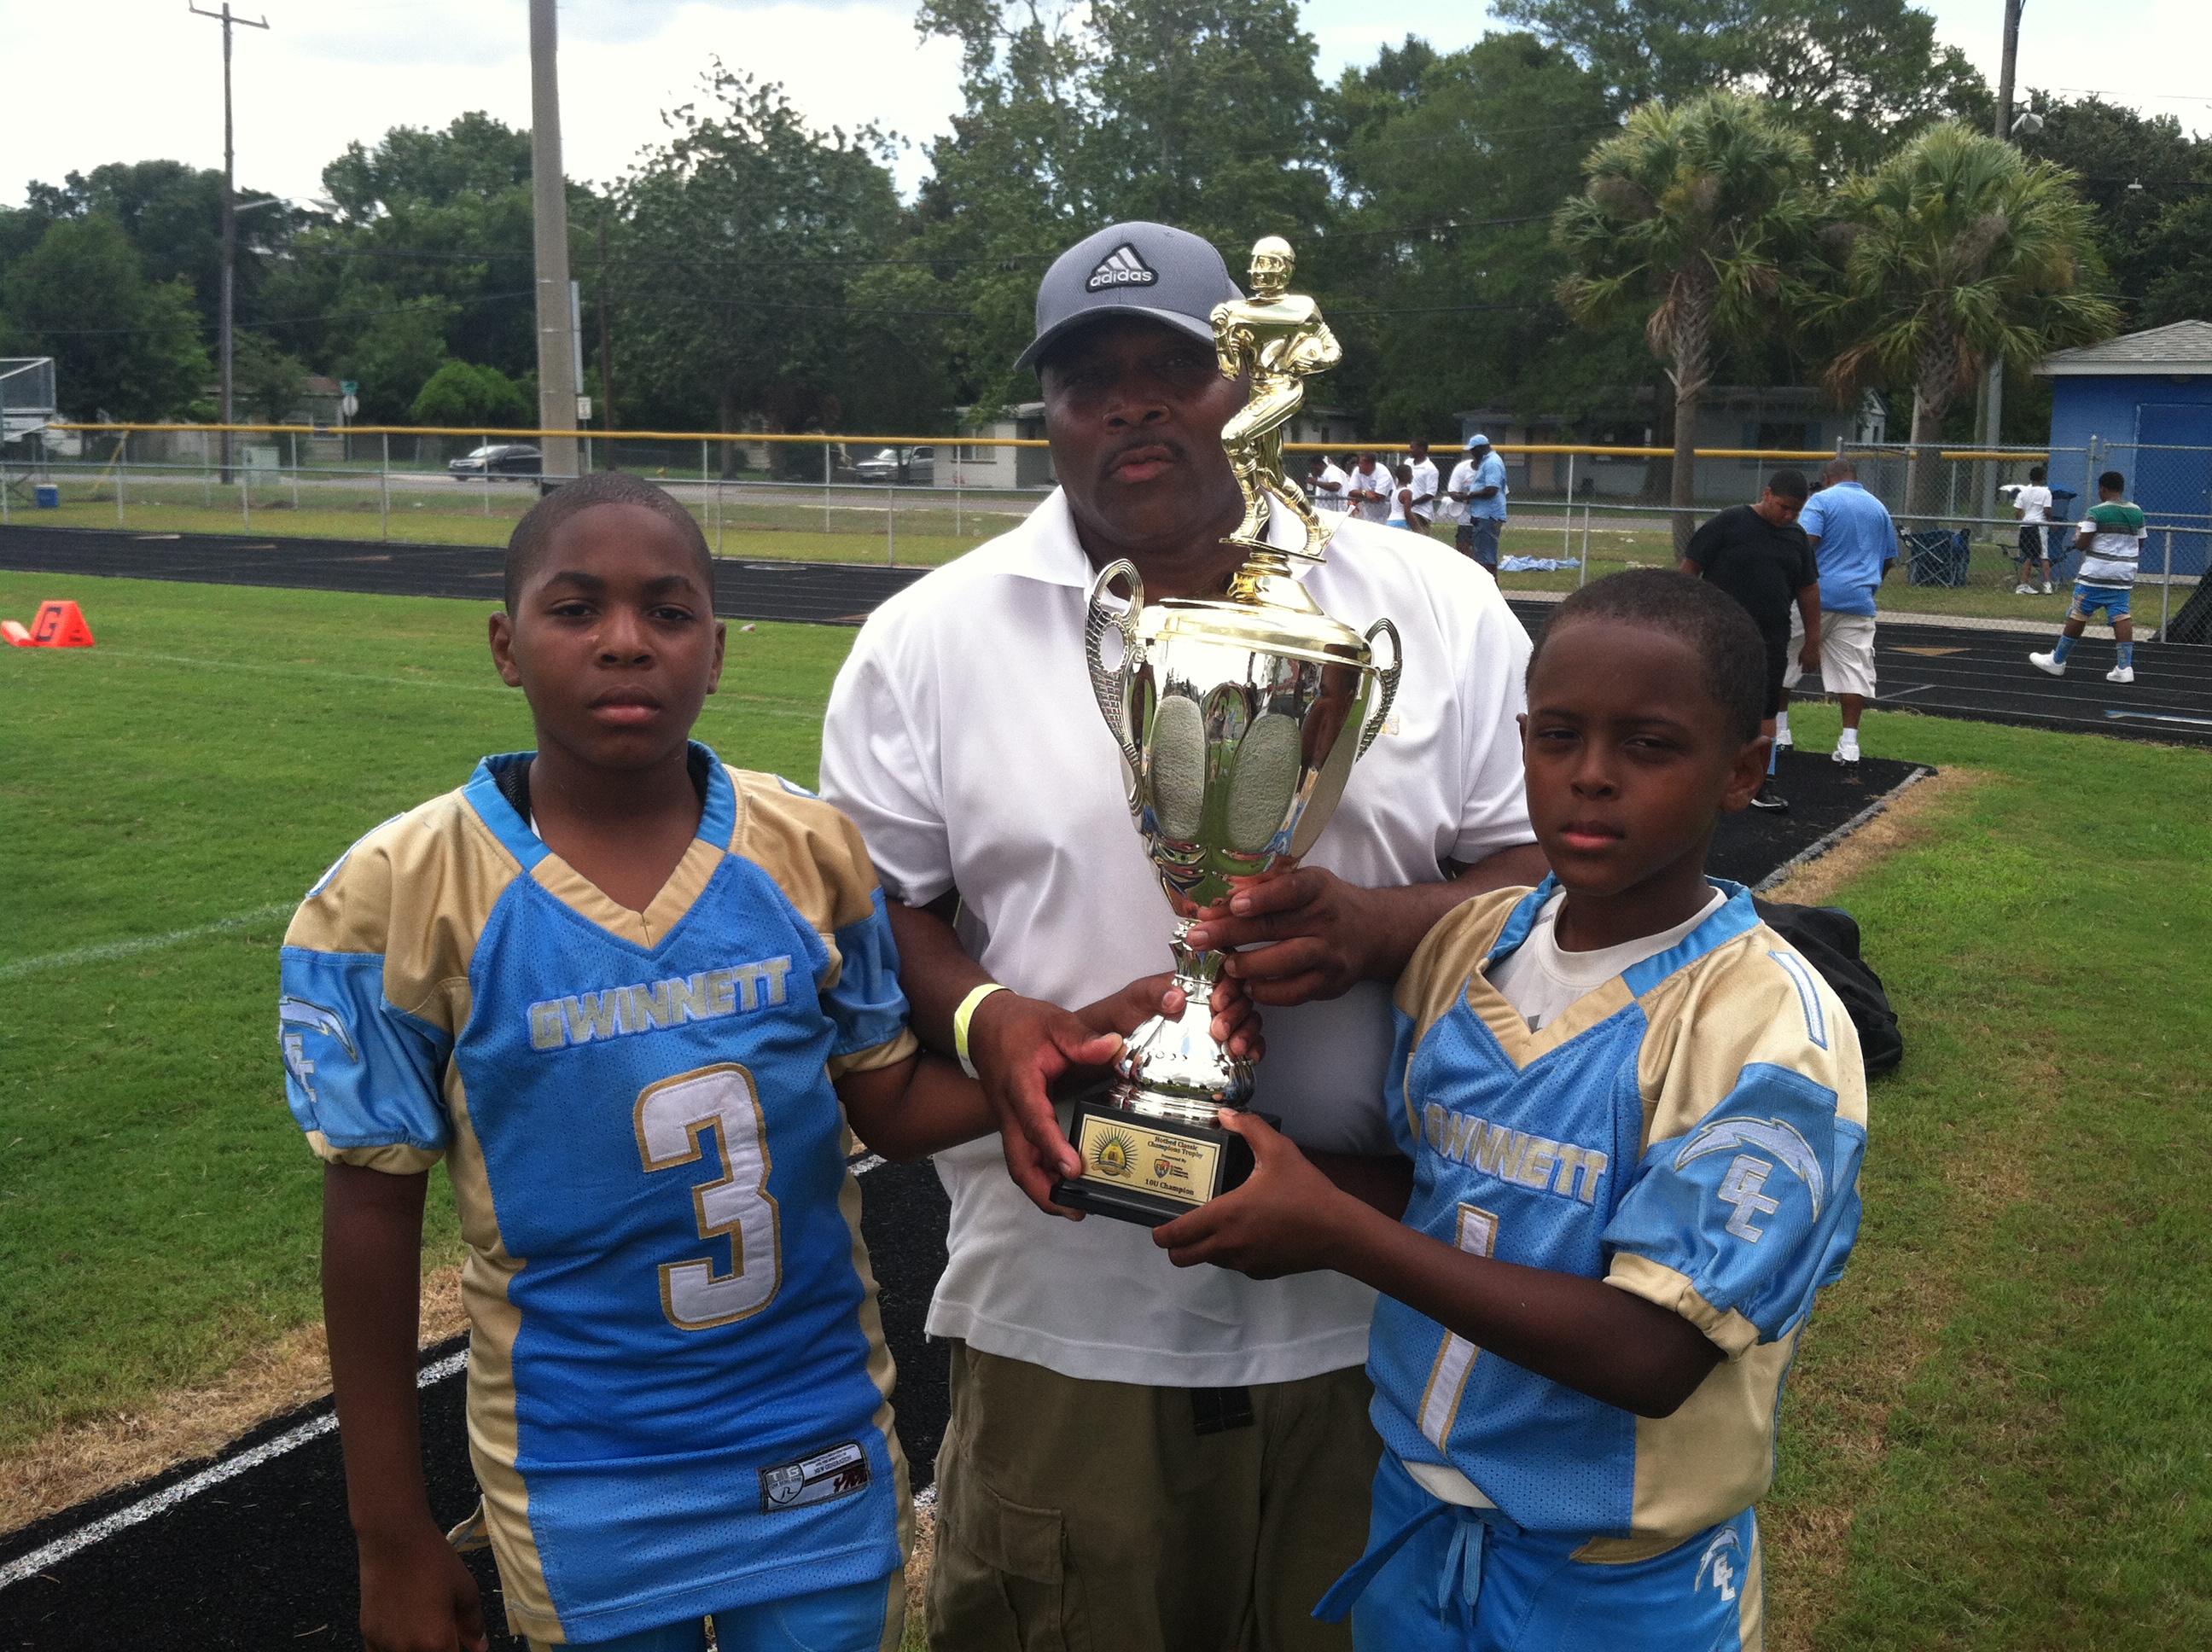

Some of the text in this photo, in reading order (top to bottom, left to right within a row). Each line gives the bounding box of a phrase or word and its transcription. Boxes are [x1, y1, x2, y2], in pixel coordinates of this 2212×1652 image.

[1090, 269, 1152, 287] adidas
[37, 607, 61, 642] G
[527, 955, 792, 1050] GWINNETT
[1178, 1142, 1198, 1151] Classic
[1182, 1149, 1203, 1159] Trophy
[1423, 1101, 1609, 1206] GWINNETT
[632, 1062, 782, 1330] 3
[1145, 1178, 1195, 1195] 10U Champion
